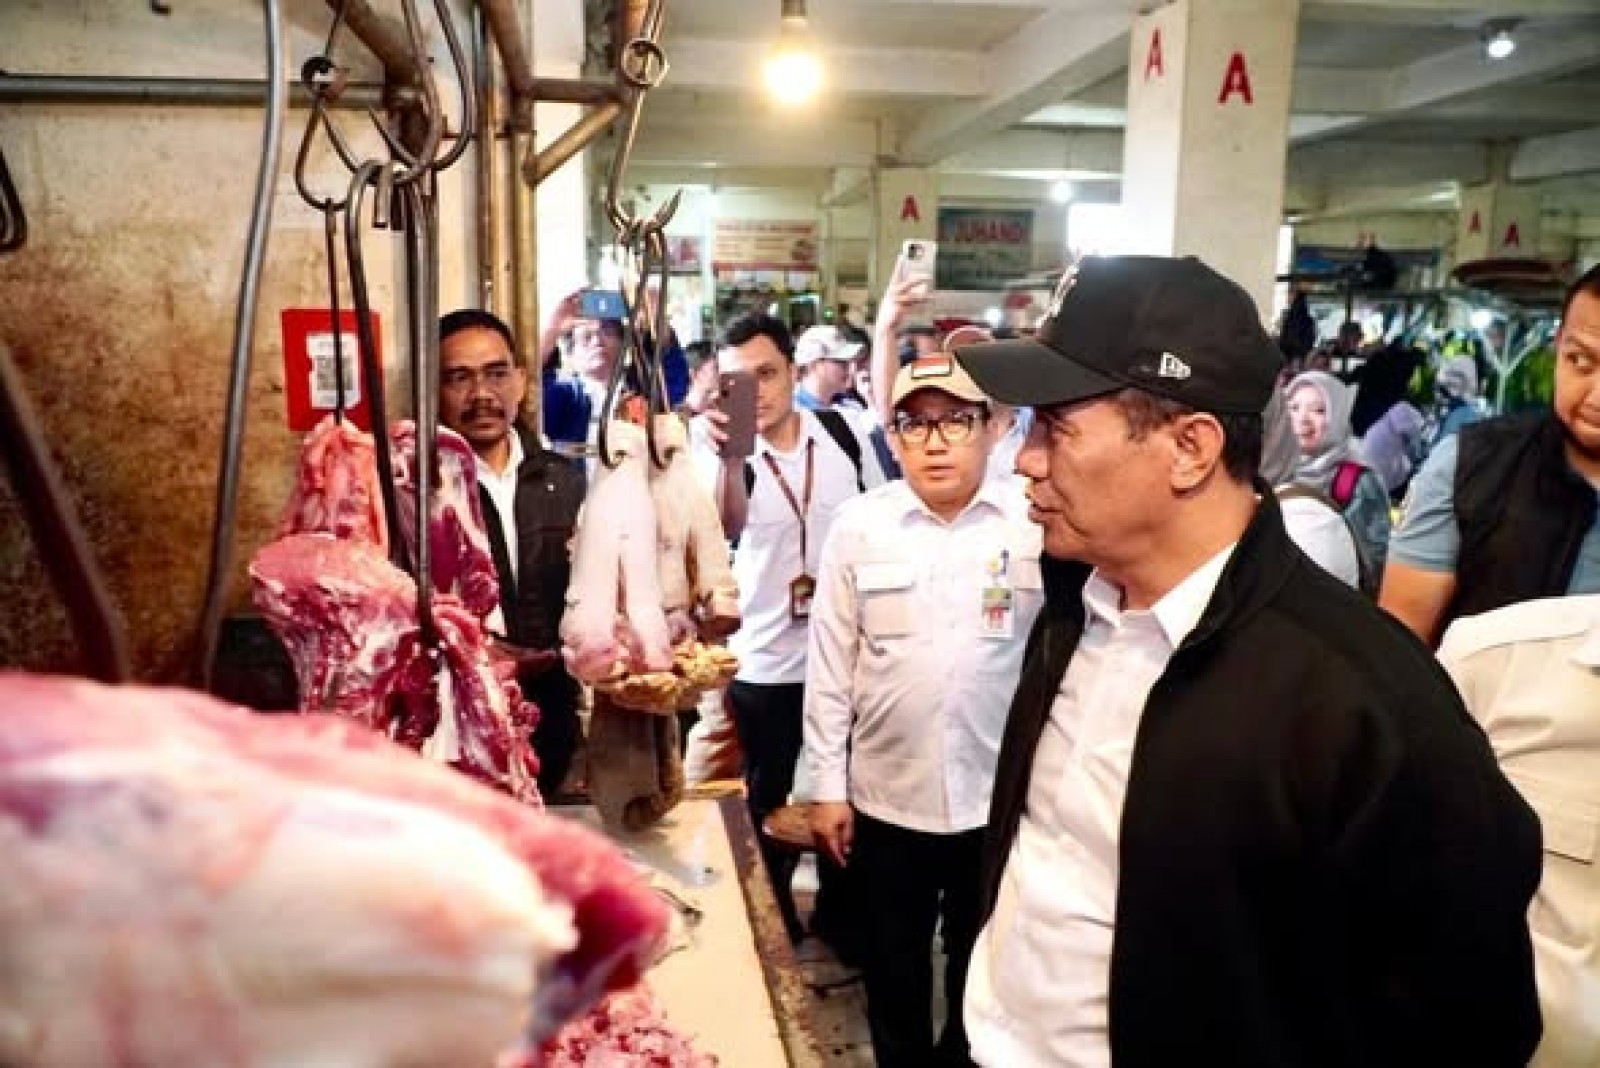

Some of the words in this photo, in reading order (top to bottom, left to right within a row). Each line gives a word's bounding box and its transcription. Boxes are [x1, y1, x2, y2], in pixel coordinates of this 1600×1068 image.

[1143, 26, 1165, 82] A
[1217, 51, 1254, 105] A
[900, 194, 921, 223] A
[1466, 209, 1482, 236] A
[1503, 221, 1521, 248] A
